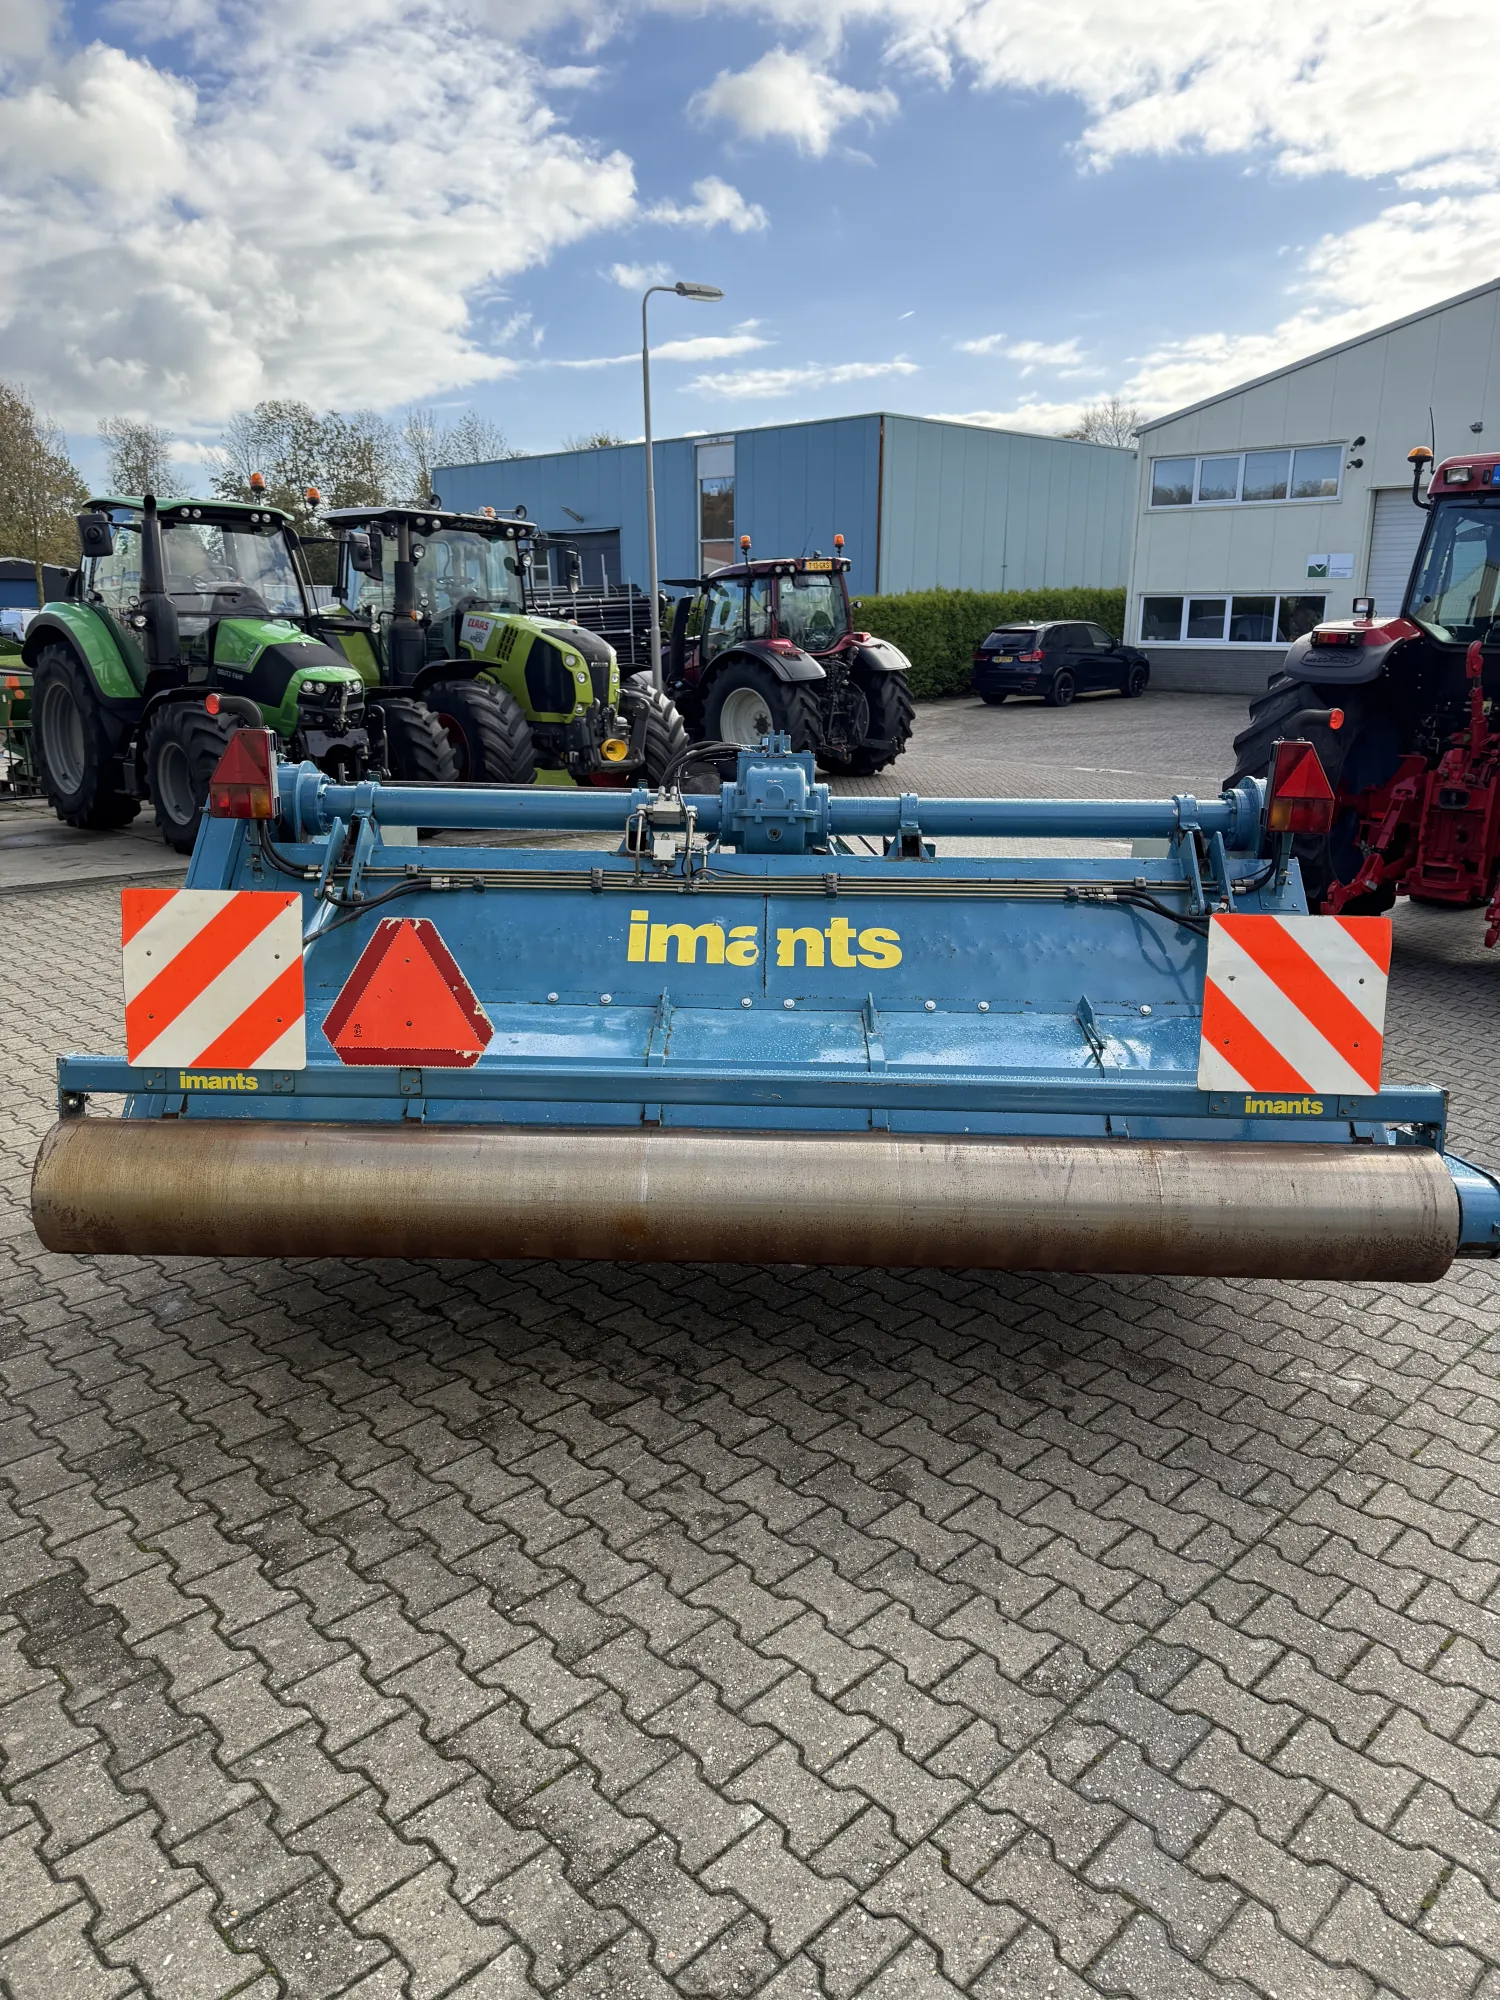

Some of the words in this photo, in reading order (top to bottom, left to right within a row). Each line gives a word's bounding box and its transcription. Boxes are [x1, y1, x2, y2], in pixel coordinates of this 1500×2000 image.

[450, 522, 497, 532] ARION
[467, 618, 490, 632] CLAAS
[216, 668, 244, 681] DEUTZ-FAHR
[179, 1071, 259, 1090] imants
[1244, 1095, 1324, 1115] imants
